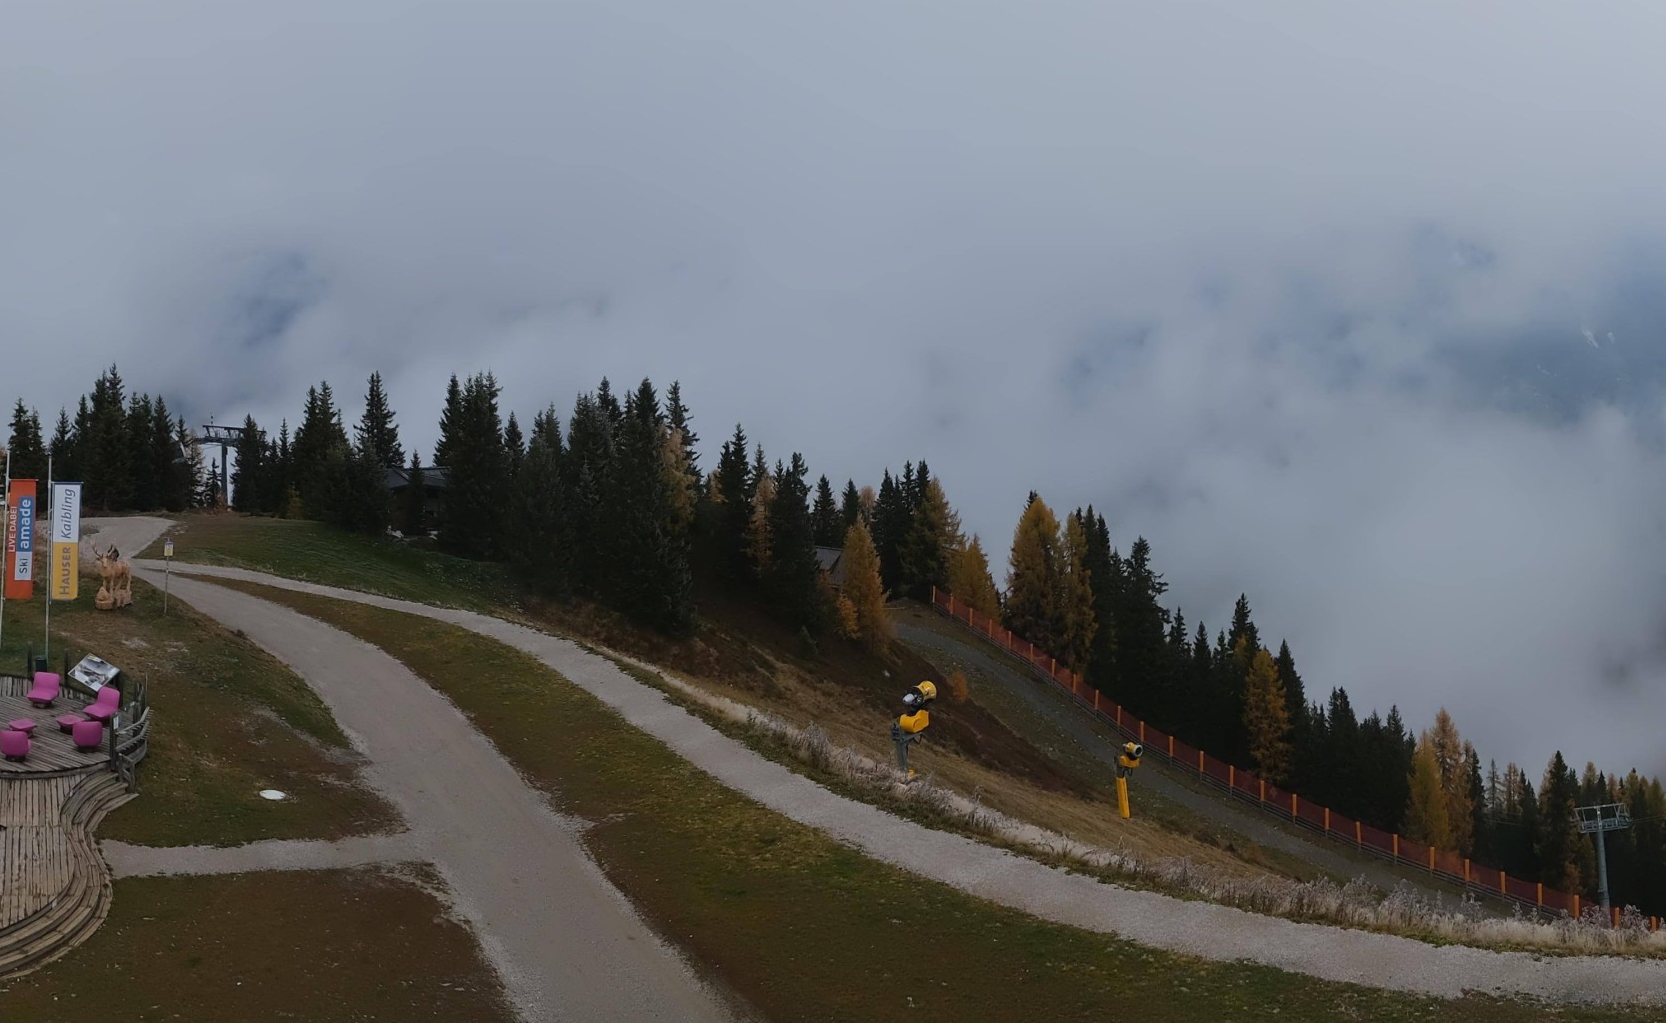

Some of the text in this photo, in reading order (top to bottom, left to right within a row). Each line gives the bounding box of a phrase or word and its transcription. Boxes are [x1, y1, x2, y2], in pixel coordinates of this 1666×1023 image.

[8, 506, 18, 552] LIVE DABEI
[59, 488, 76, 595] HAUSER Kaibling
[19, 558, 28, 574] Ski
